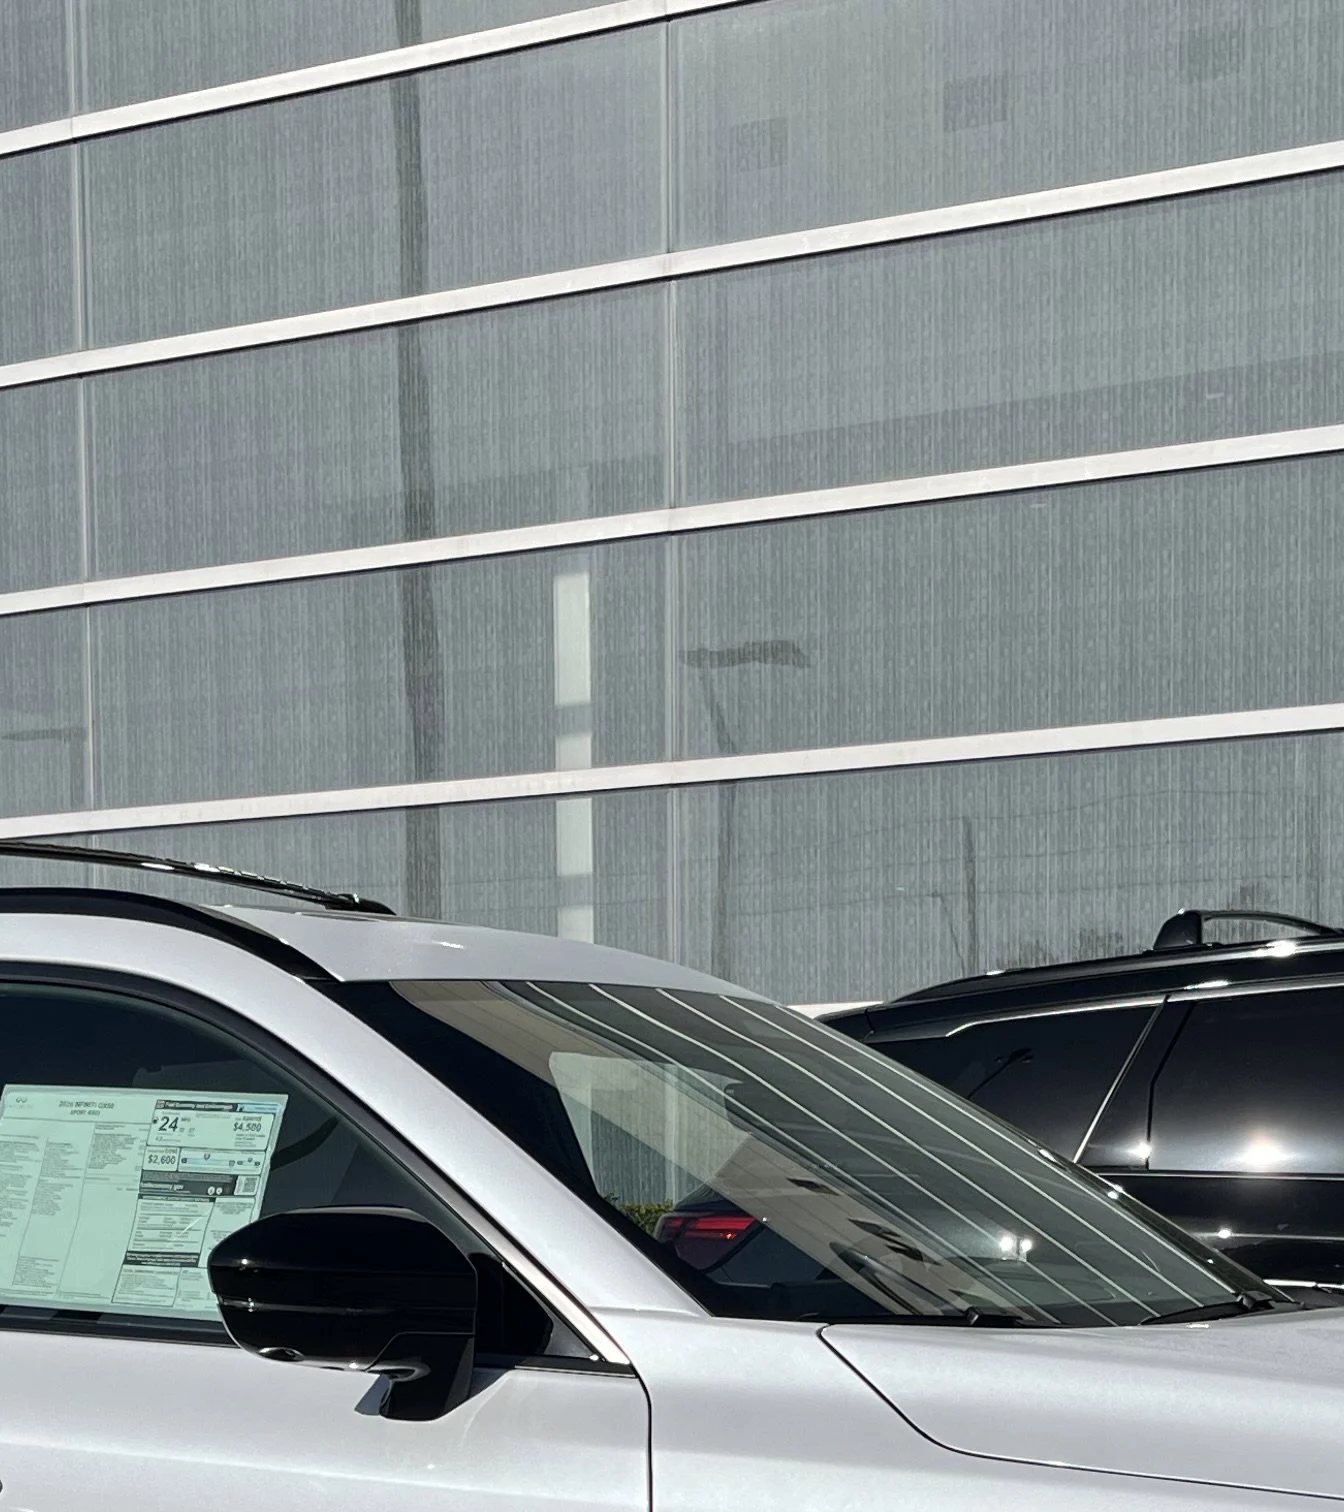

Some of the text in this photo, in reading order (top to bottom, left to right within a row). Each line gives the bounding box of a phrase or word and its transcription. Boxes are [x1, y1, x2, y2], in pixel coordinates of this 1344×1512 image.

[158, 1116, 179, 1132] 24
[233, 1121, 262, 1132] $4,500
[147, 1154, 176, 1166] $2,600
